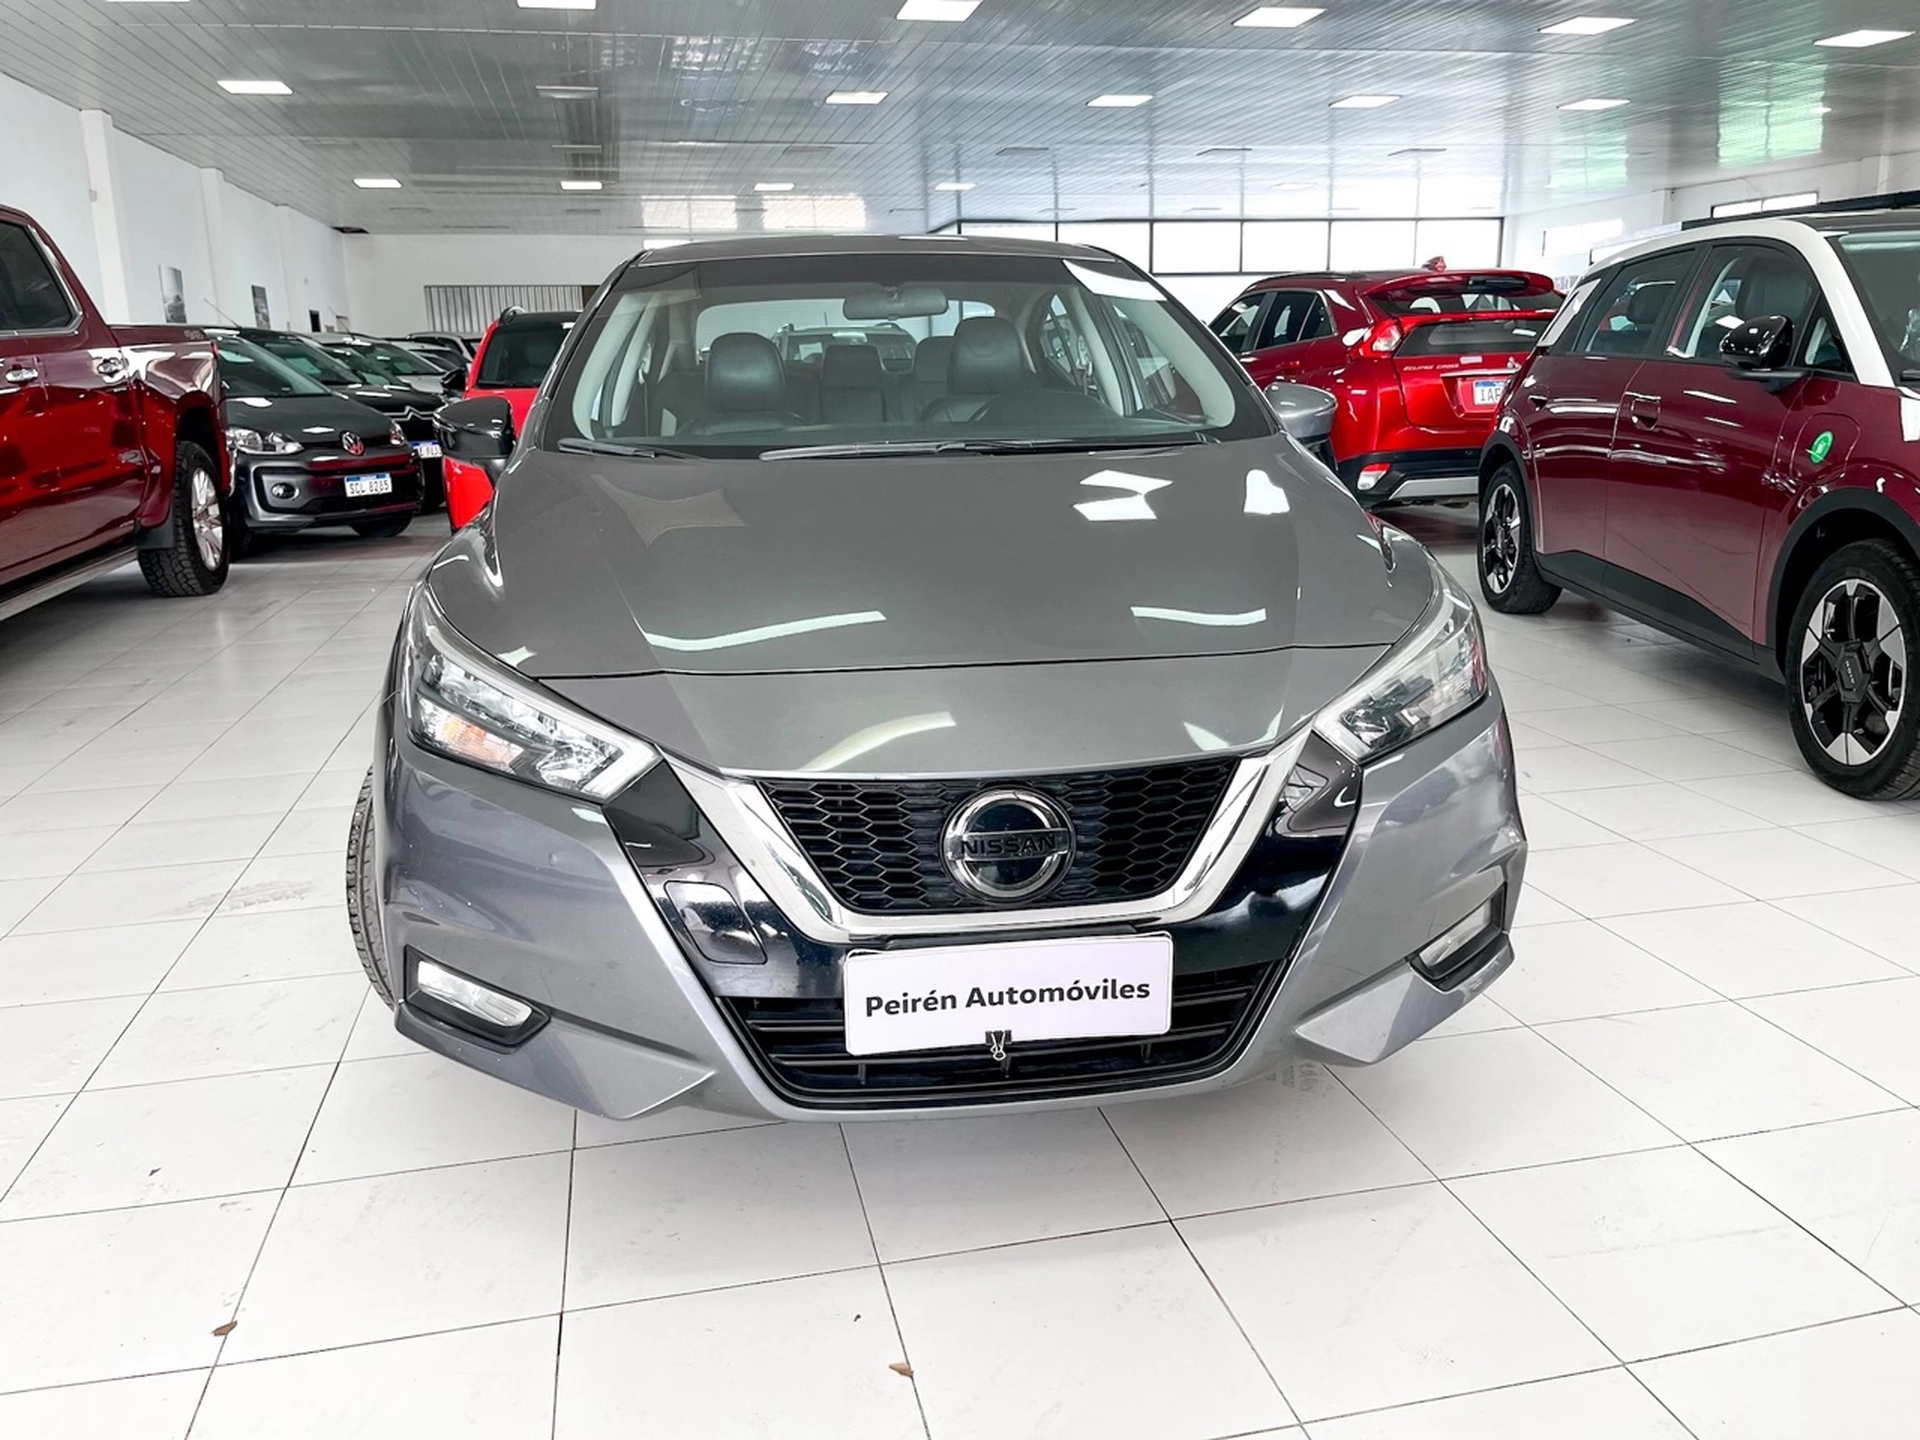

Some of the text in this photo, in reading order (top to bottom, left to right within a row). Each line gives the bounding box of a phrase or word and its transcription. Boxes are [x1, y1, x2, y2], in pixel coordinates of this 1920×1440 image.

[961, 834, 1056, 855] NISSAN
[866, 978, 1150, 1017] Peirén Automóviles
